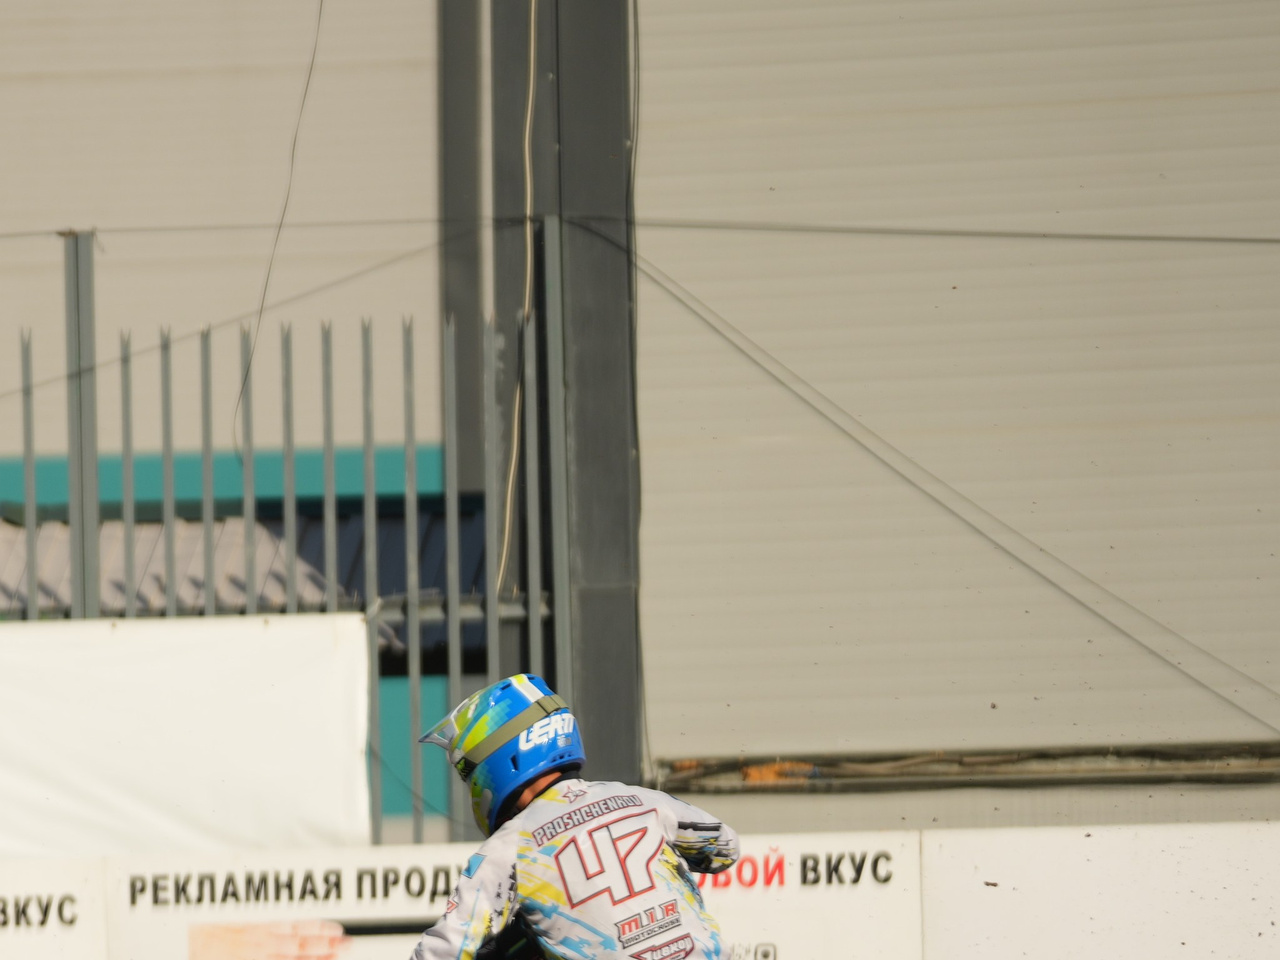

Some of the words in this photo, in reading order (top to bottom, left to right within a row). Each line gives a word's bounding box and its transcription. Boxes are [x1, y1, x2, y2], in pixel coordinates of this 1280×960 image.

[532, 794, 643, 847] PROSHCHENKOV
[554, 808, 665, 909] 47
[800, 850, 894, 886] ВКУС
[130, 869, 341, 906] РЕКЛАМНАЯ
